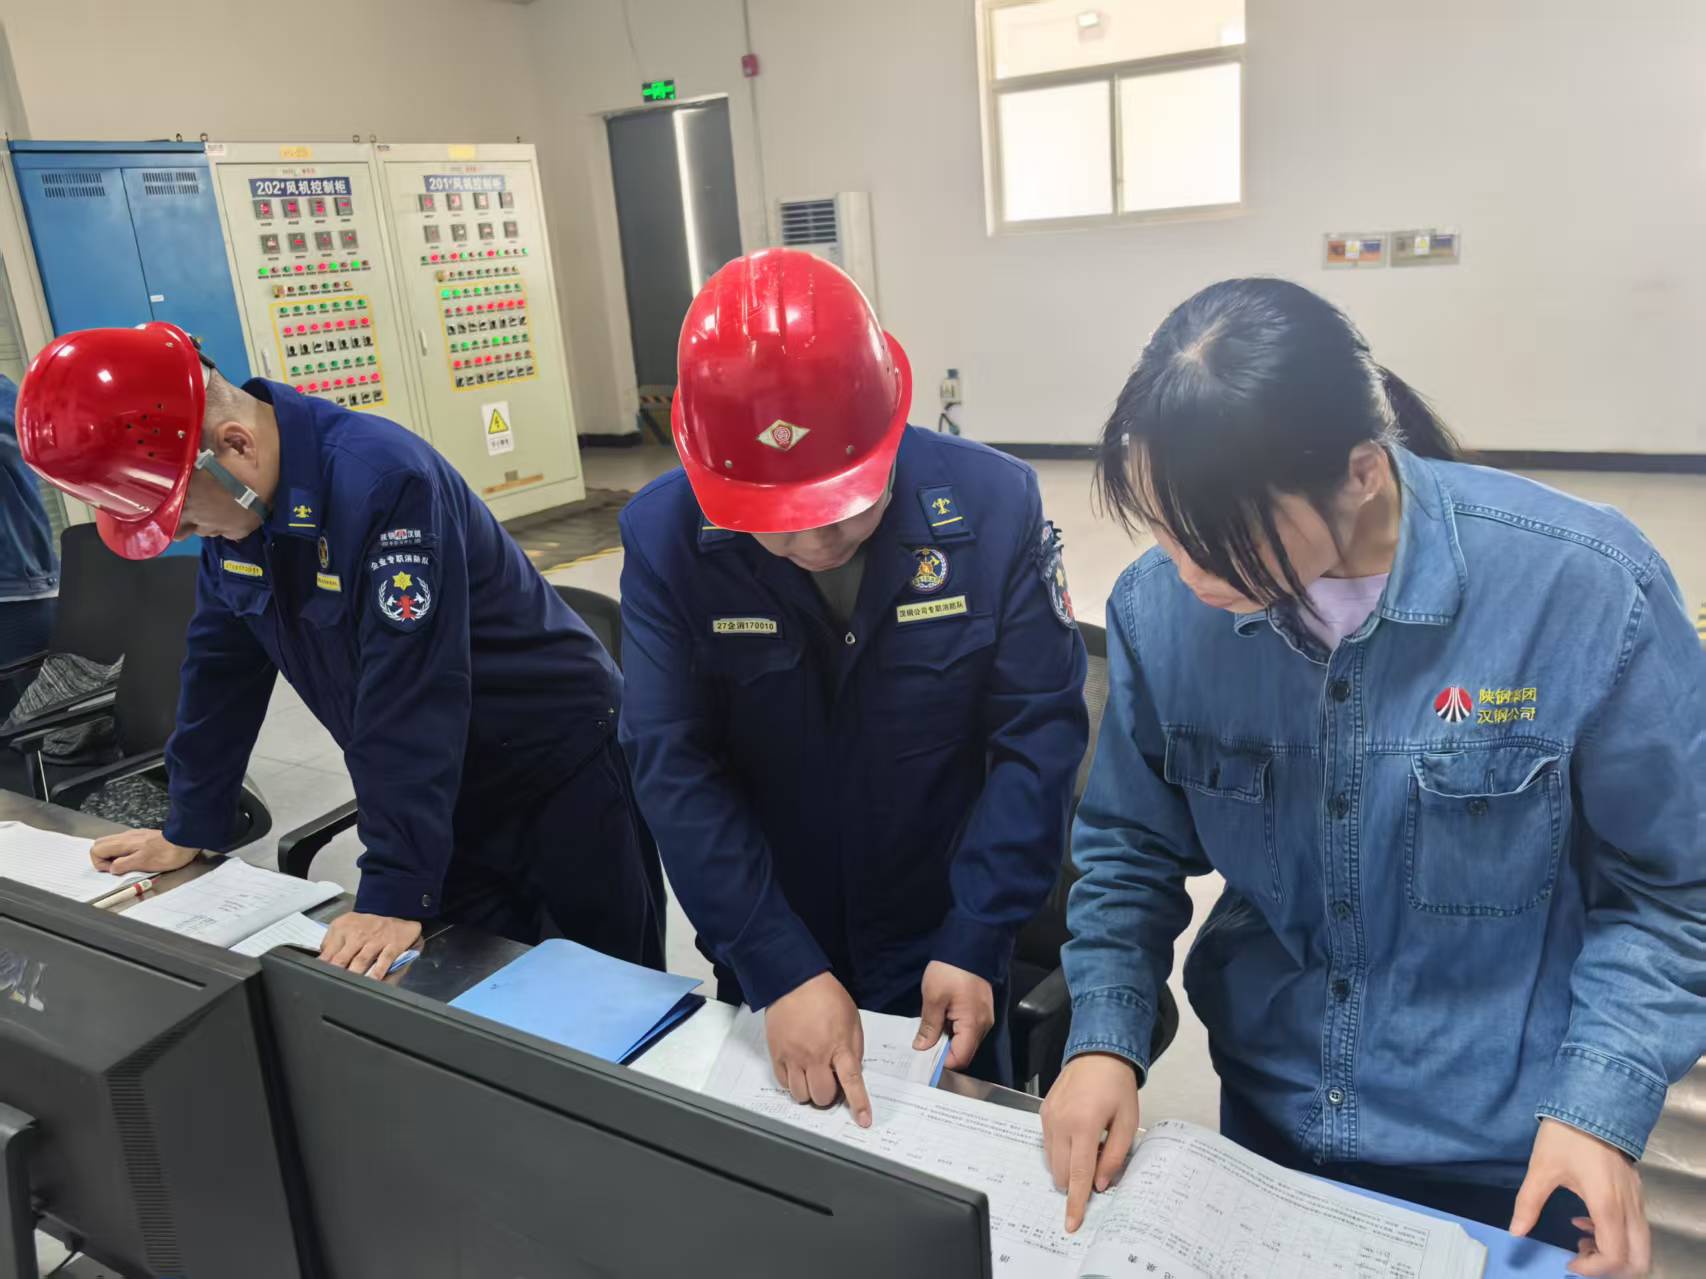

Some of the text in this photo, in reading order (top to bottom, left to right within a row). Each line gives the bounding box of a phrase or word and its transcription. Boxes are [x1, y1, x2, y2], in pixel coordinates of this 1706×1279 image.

[1479, 687, 1537, 705] 陕钢集团
[1476, 707, 1537, 724] 汉钢公司
